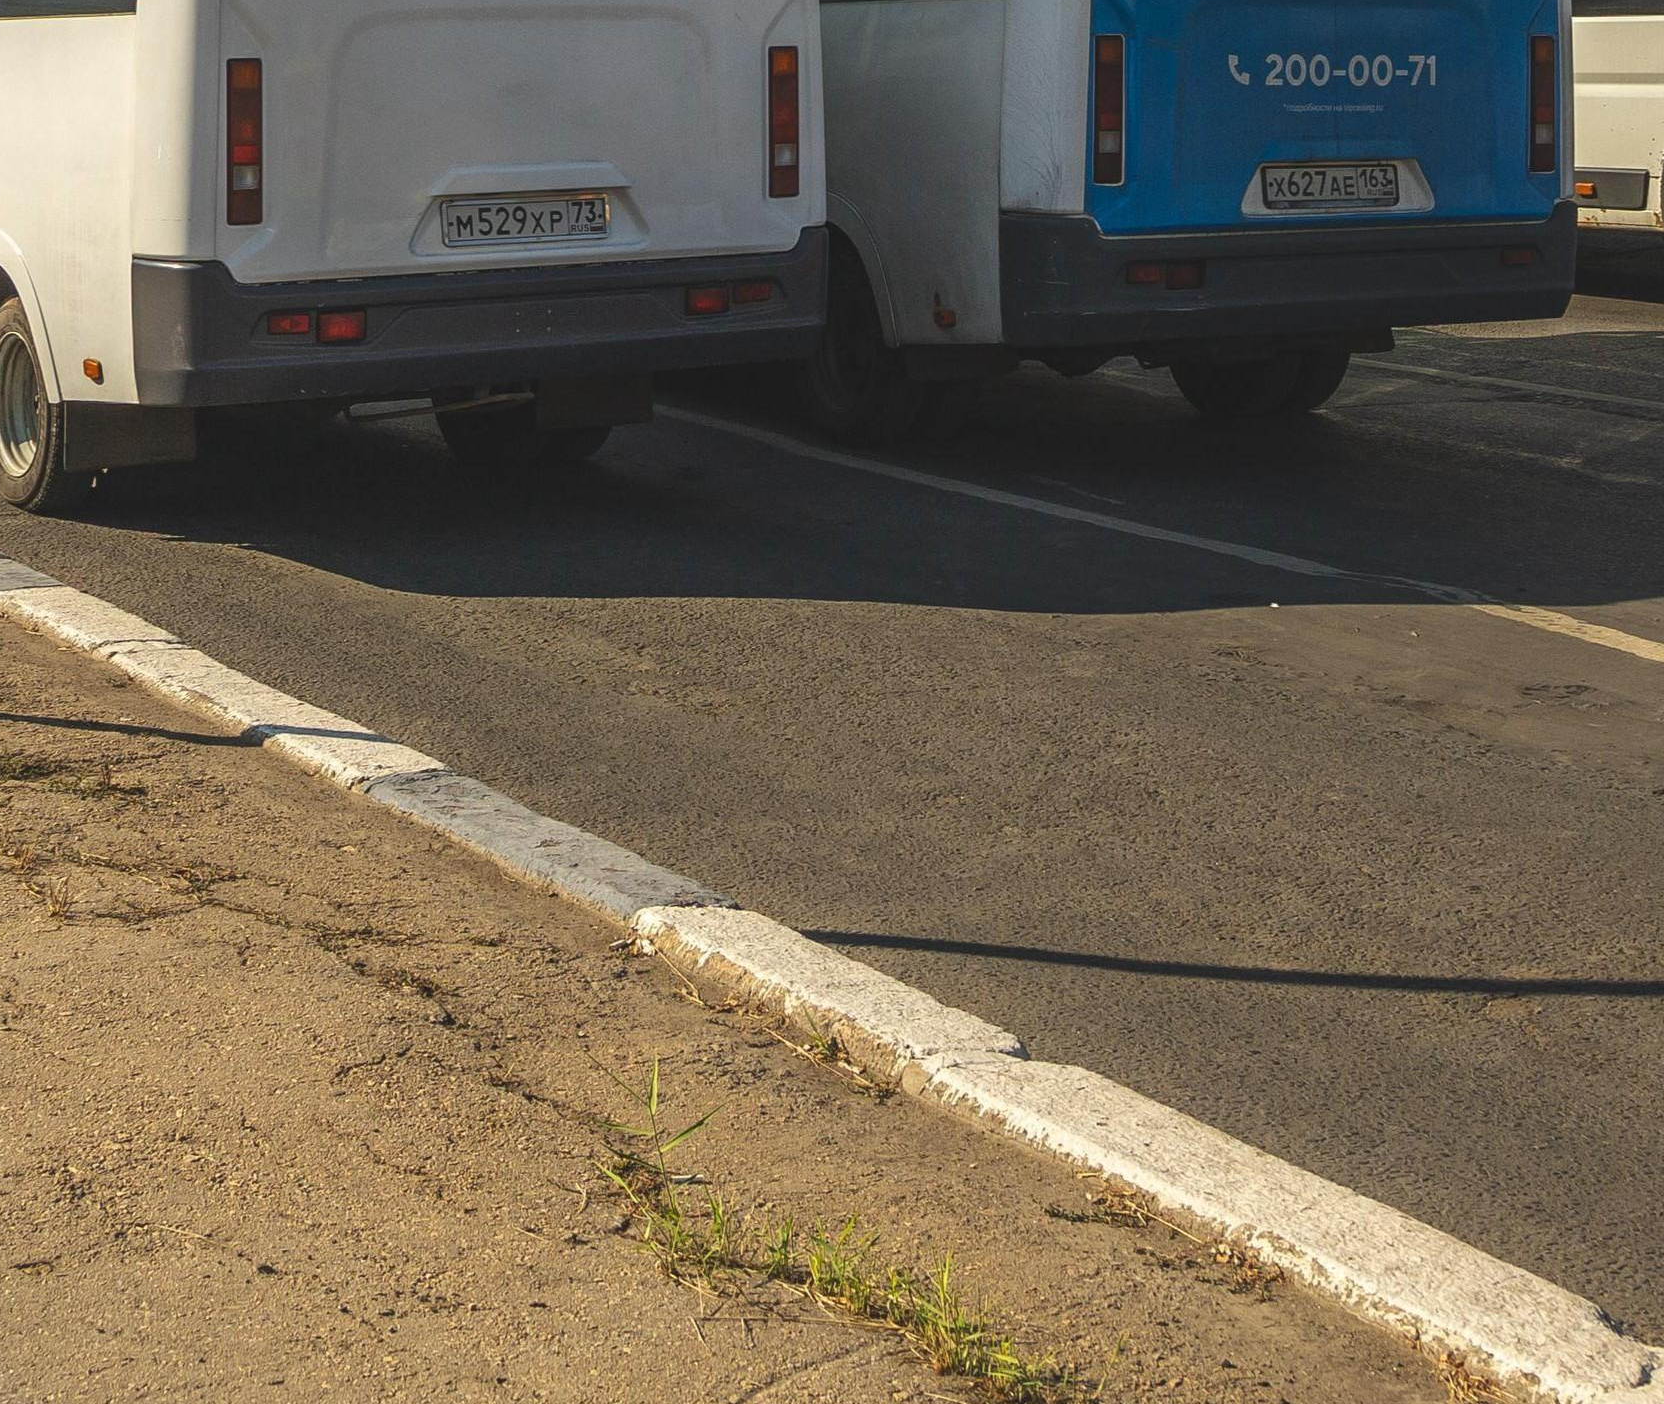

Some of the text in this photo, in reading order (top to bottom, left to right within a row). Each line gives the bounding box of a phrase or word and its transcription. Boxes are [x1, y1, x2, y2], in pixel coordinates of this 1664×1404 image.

[1264, 53, 1437, 87] 200-00-71
[1359, 168, 1390, 188] 163
[571, 201, 597, 224] 73
[570, 224, 590, 233] RUS
